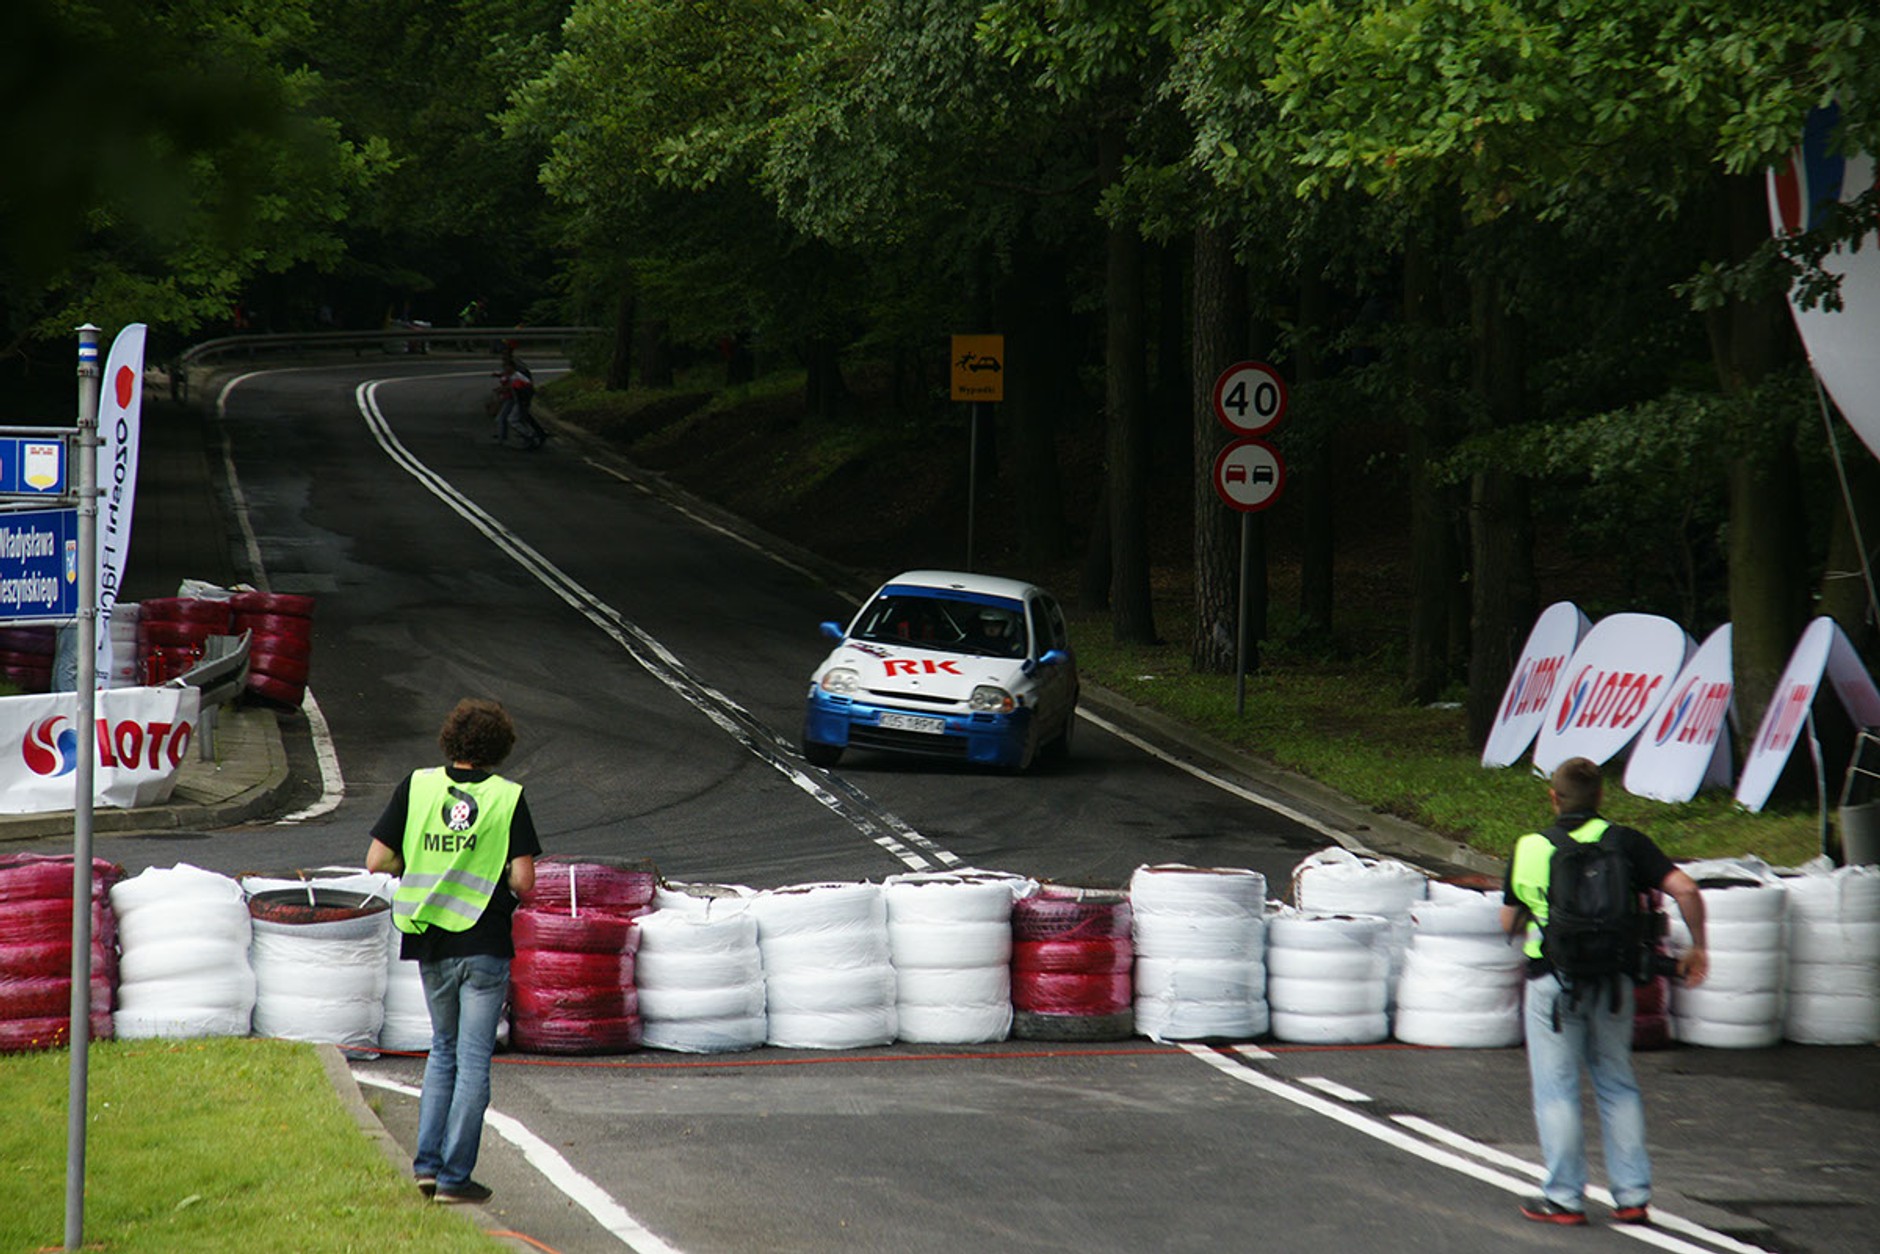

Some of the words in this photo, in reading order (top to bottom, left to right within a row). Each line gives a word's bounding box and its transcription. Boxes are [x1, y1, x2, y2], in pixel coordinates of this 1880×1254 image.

[1225, 381, 1278, 417] 40
[882, 659, 965, 677] RK
[1575, 671, 1664, 729] LOTOS
